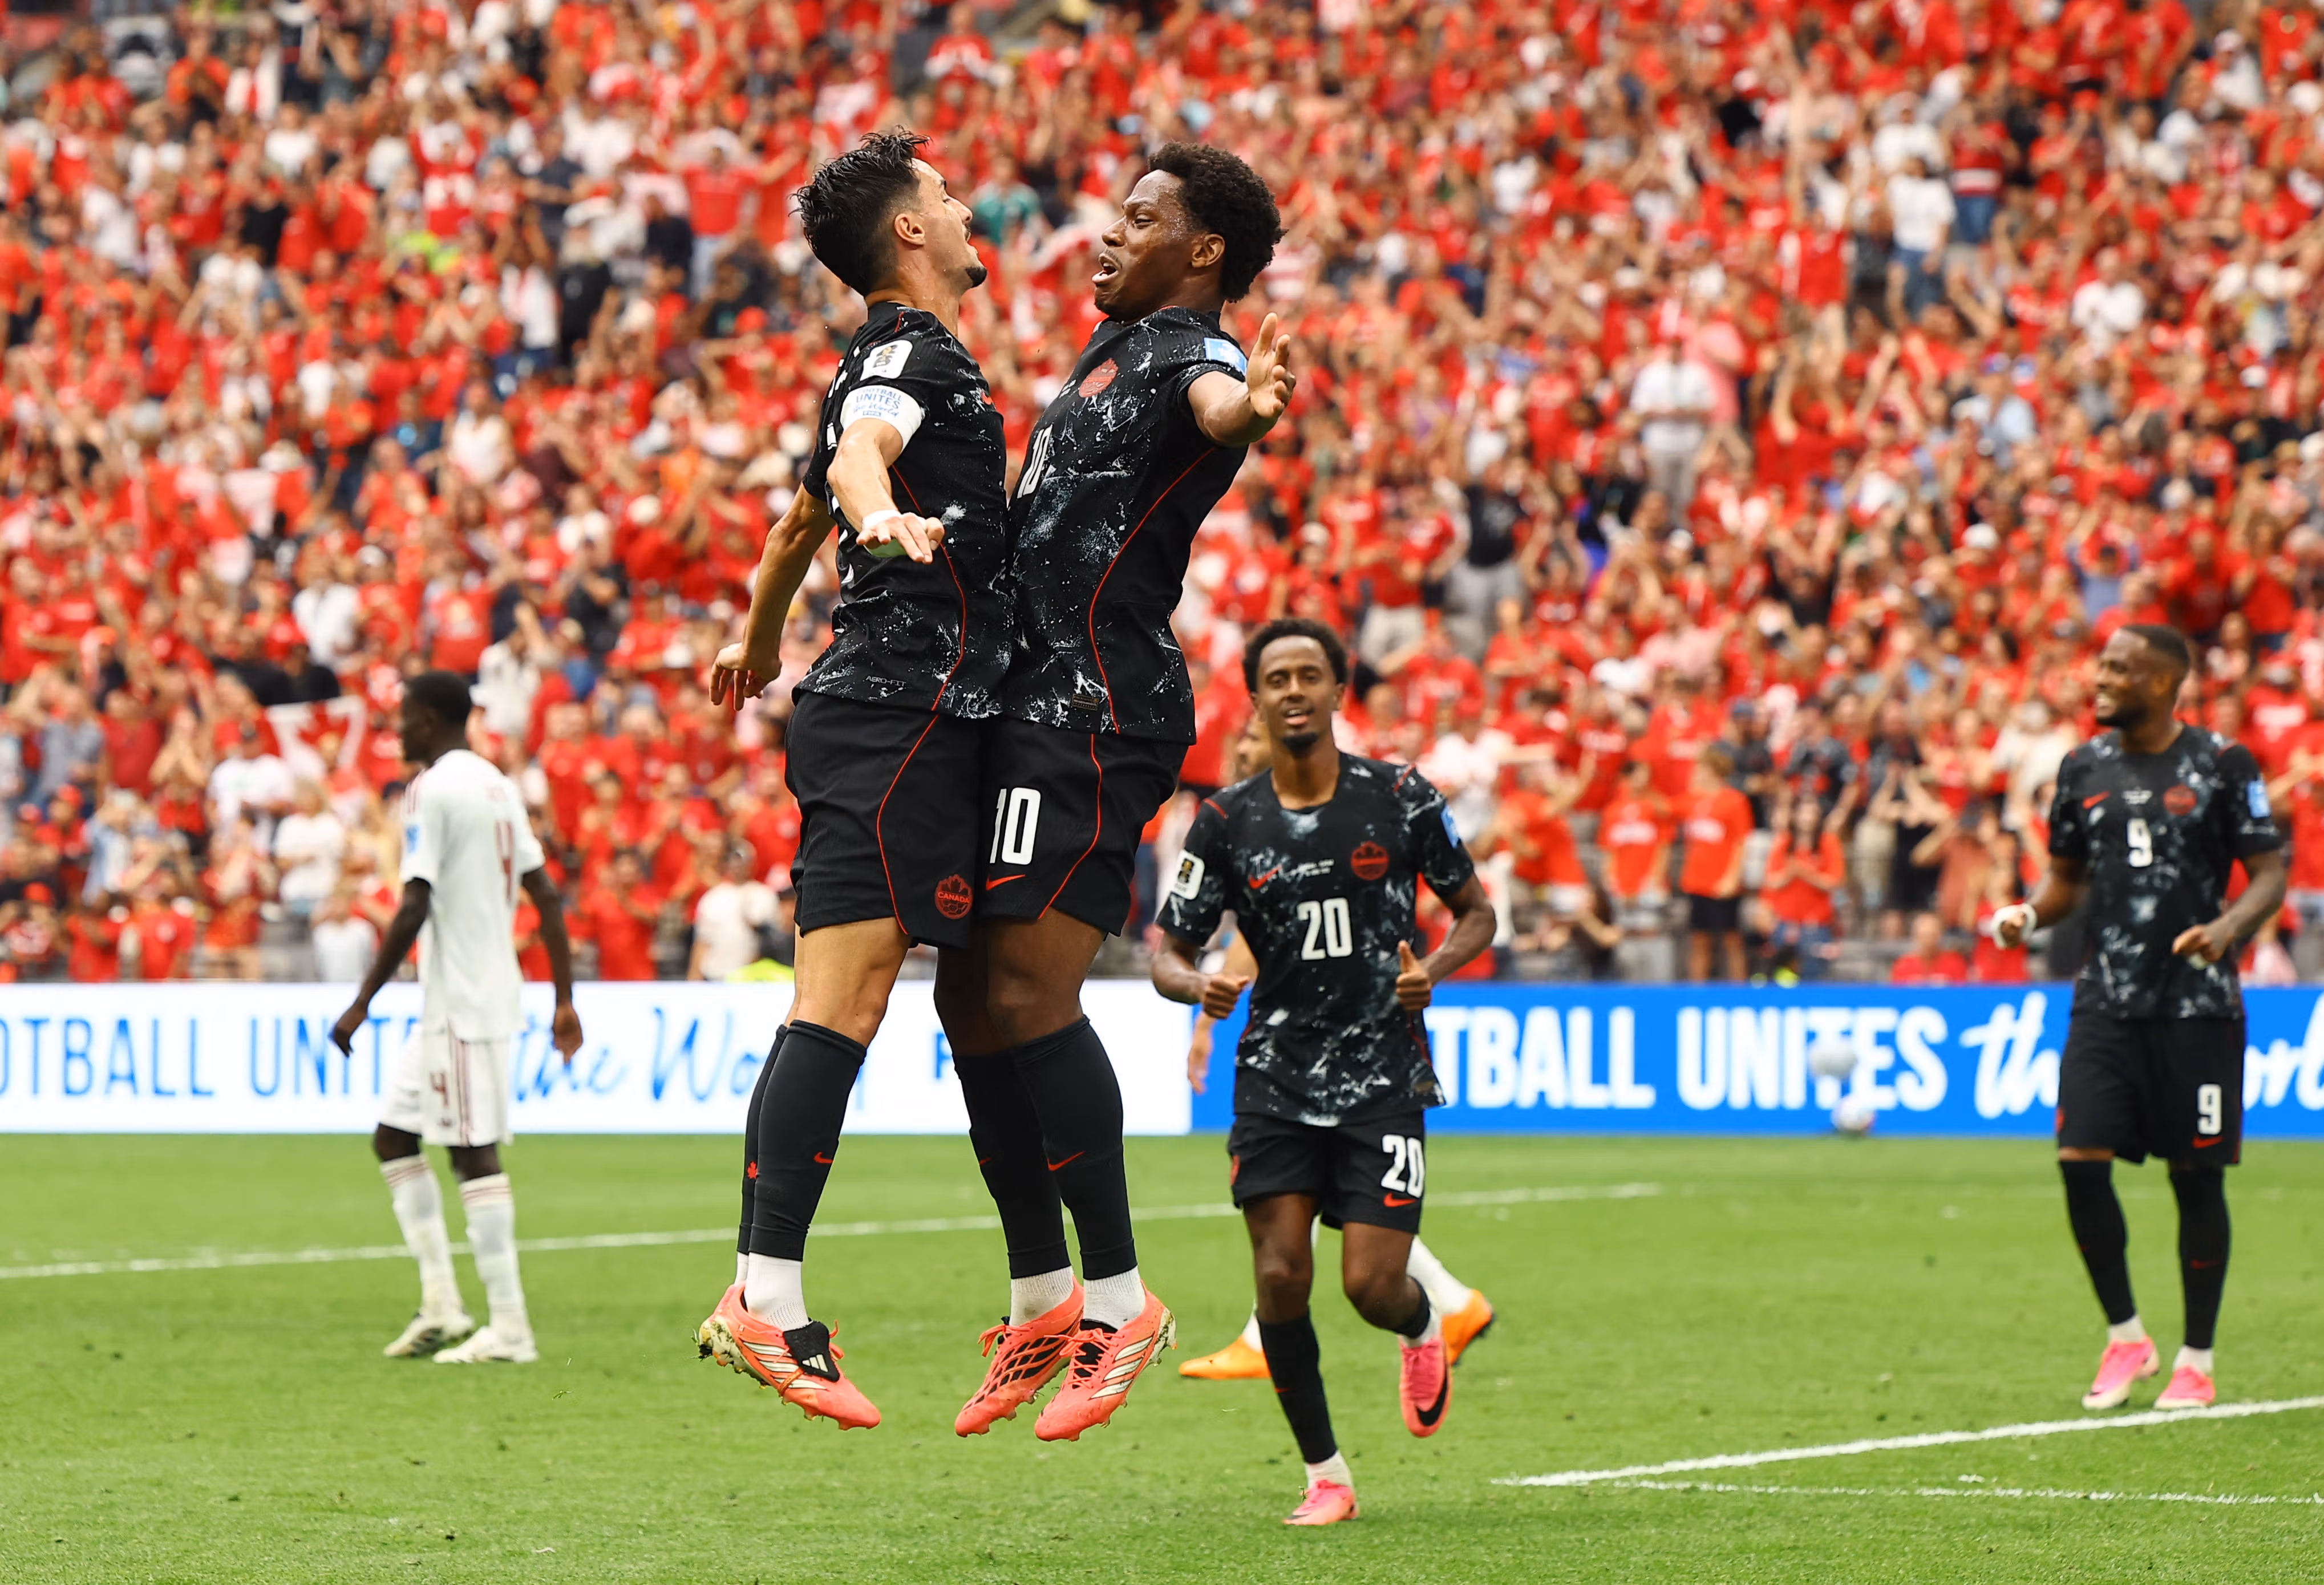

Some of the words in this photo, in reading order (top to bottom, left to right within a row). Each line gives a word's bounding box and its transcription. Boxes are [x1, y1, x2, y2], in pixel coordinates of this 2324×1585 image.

[856, 393, 900, 409] UNITES
[1017, 424, 1053, 499] 10
[865, 675, 906, 687] AERO-FIT
[989, 787, 1041, 865] 10
[2127, 818, 2153, 868] 9
[937, 891, 970, 904] CANADA
[1297, 897, 1353, 961] 20
[1423, 1006, 1656, 1108] TBALL
[1677, 1006, 1948, 1111] UNITES
[1958, 991, 2060, 1119] th
[429, 1071, 450, 1108] 4
[2197, 1084, 2221, 1135] 9
[1380, 1133, 1426, 1198] 20
